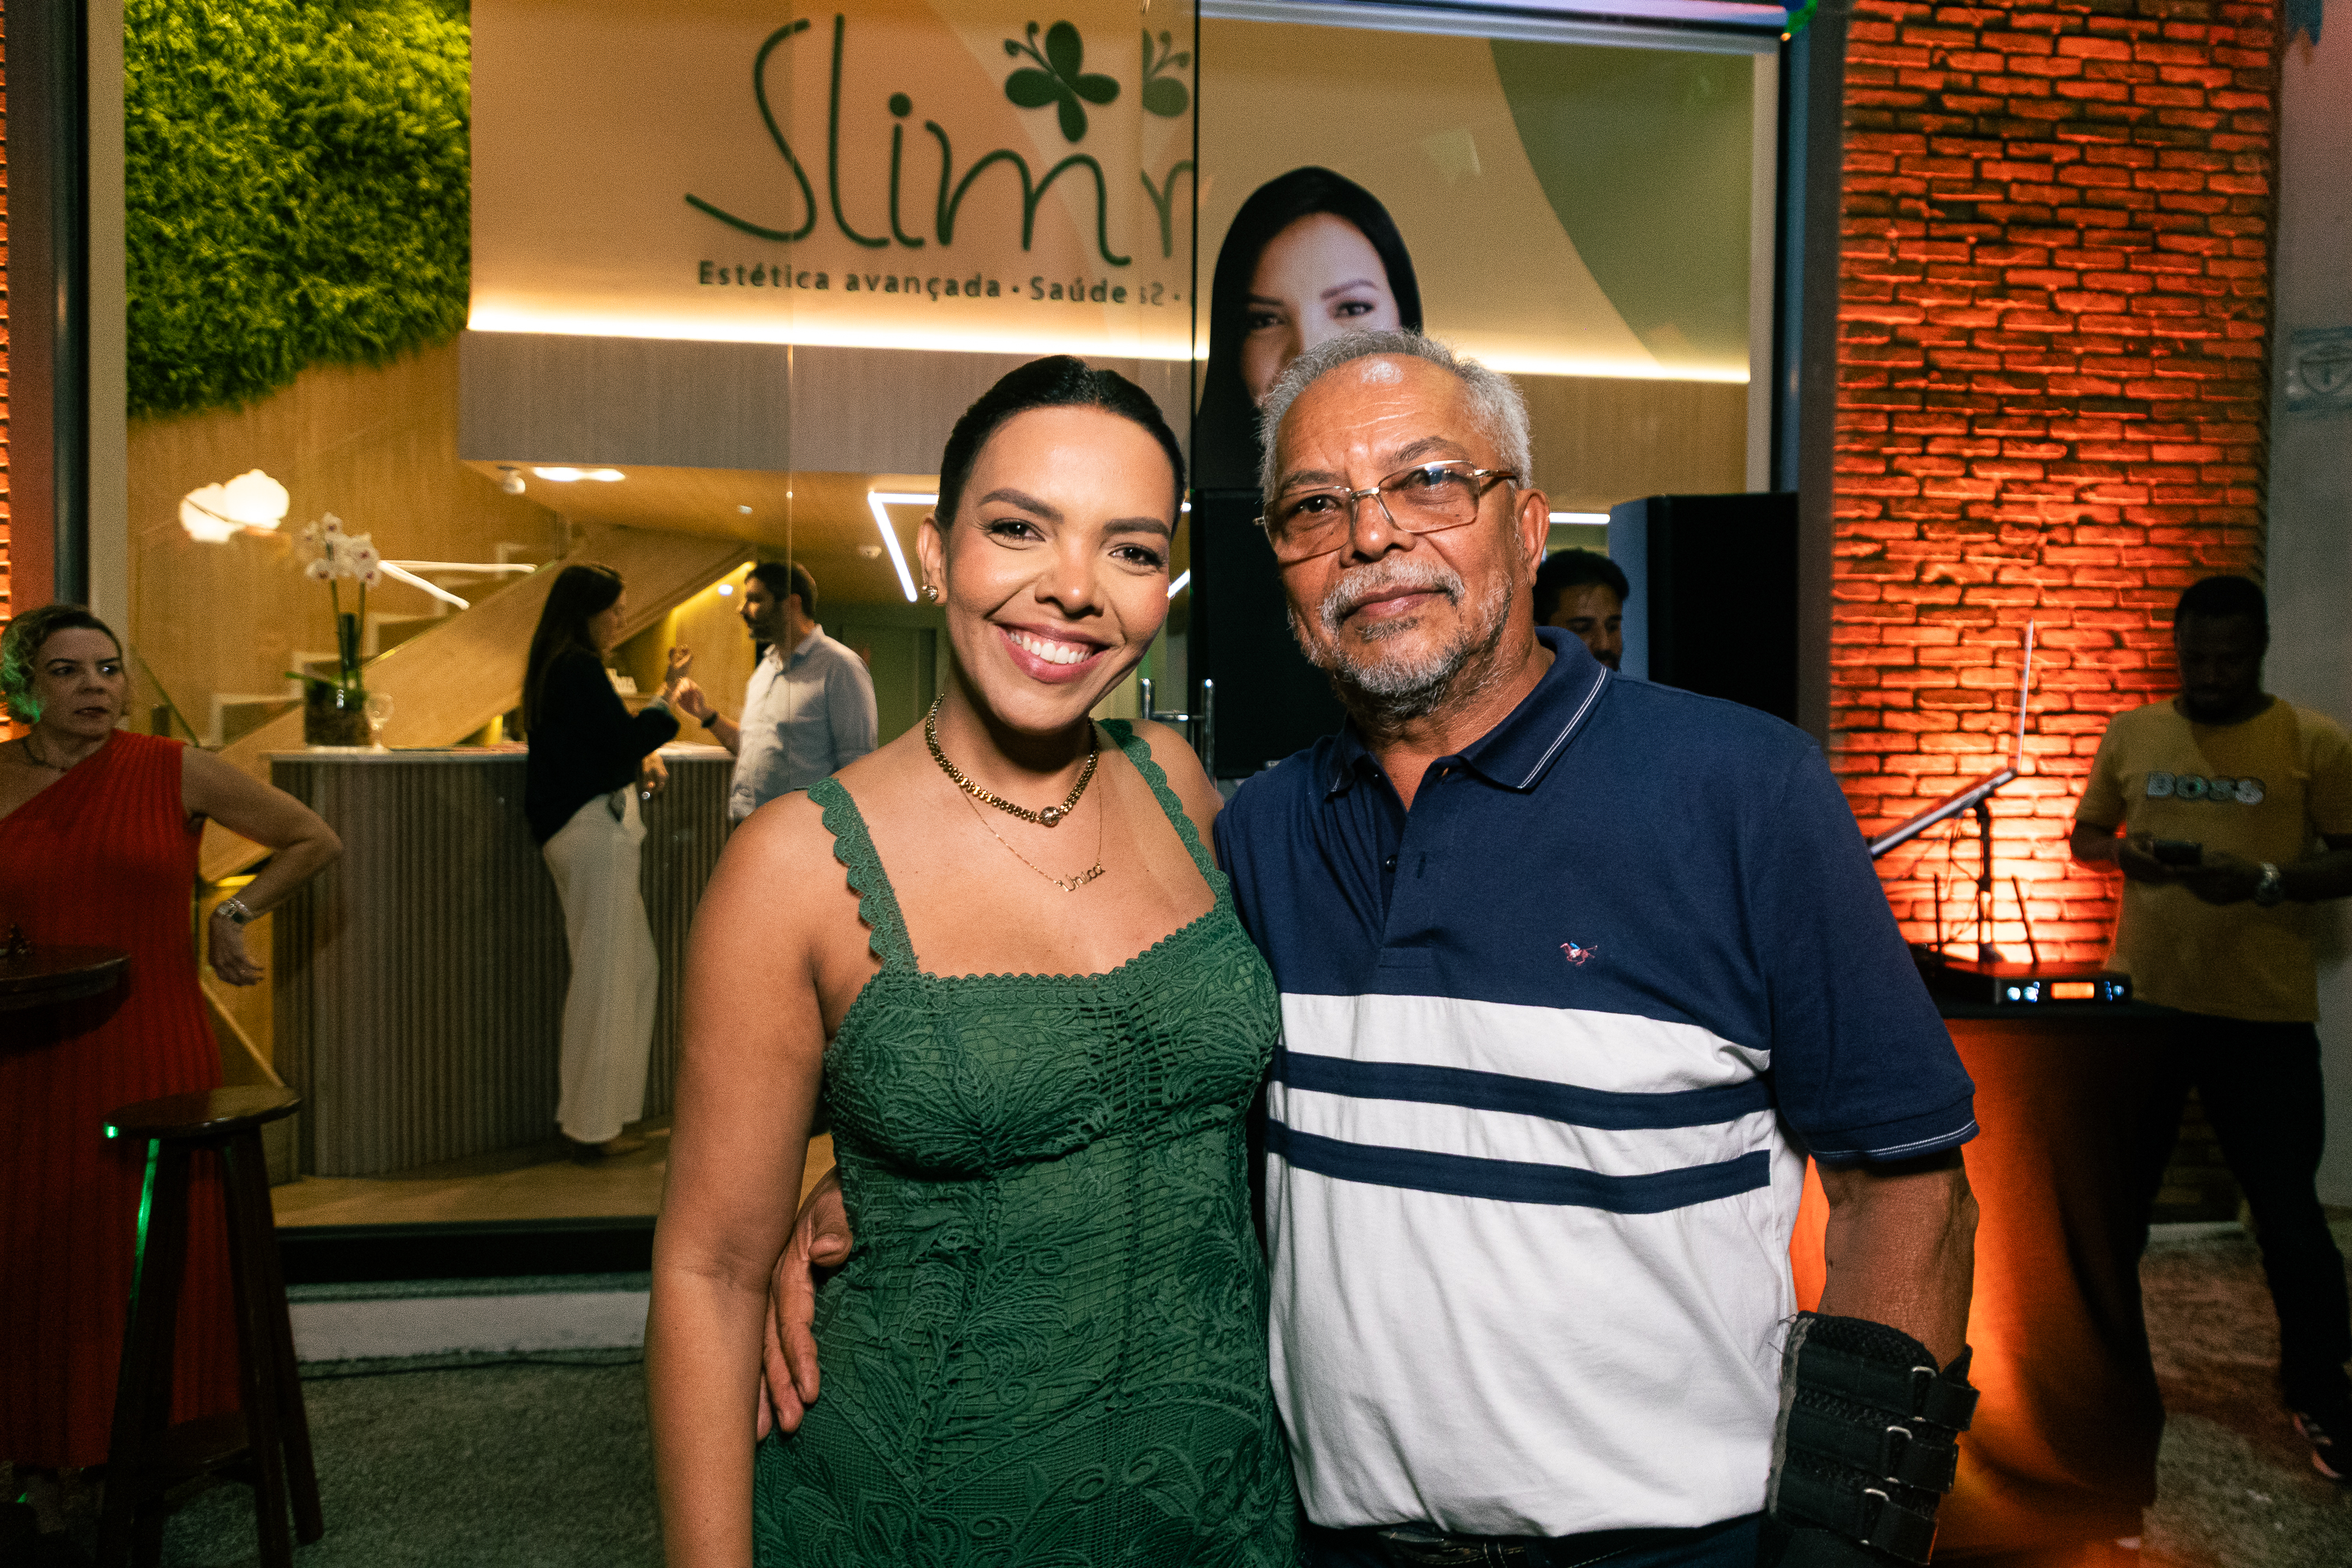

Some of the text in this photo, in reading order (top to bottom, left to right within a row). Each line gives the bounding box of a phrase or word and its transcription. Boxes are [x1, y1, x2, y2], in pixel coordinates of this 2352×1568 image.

[699, 260, 829, 291] Estética
[846, 271, 1001, 302] avançada
[1029, 275, 1127, 303] Saúde
